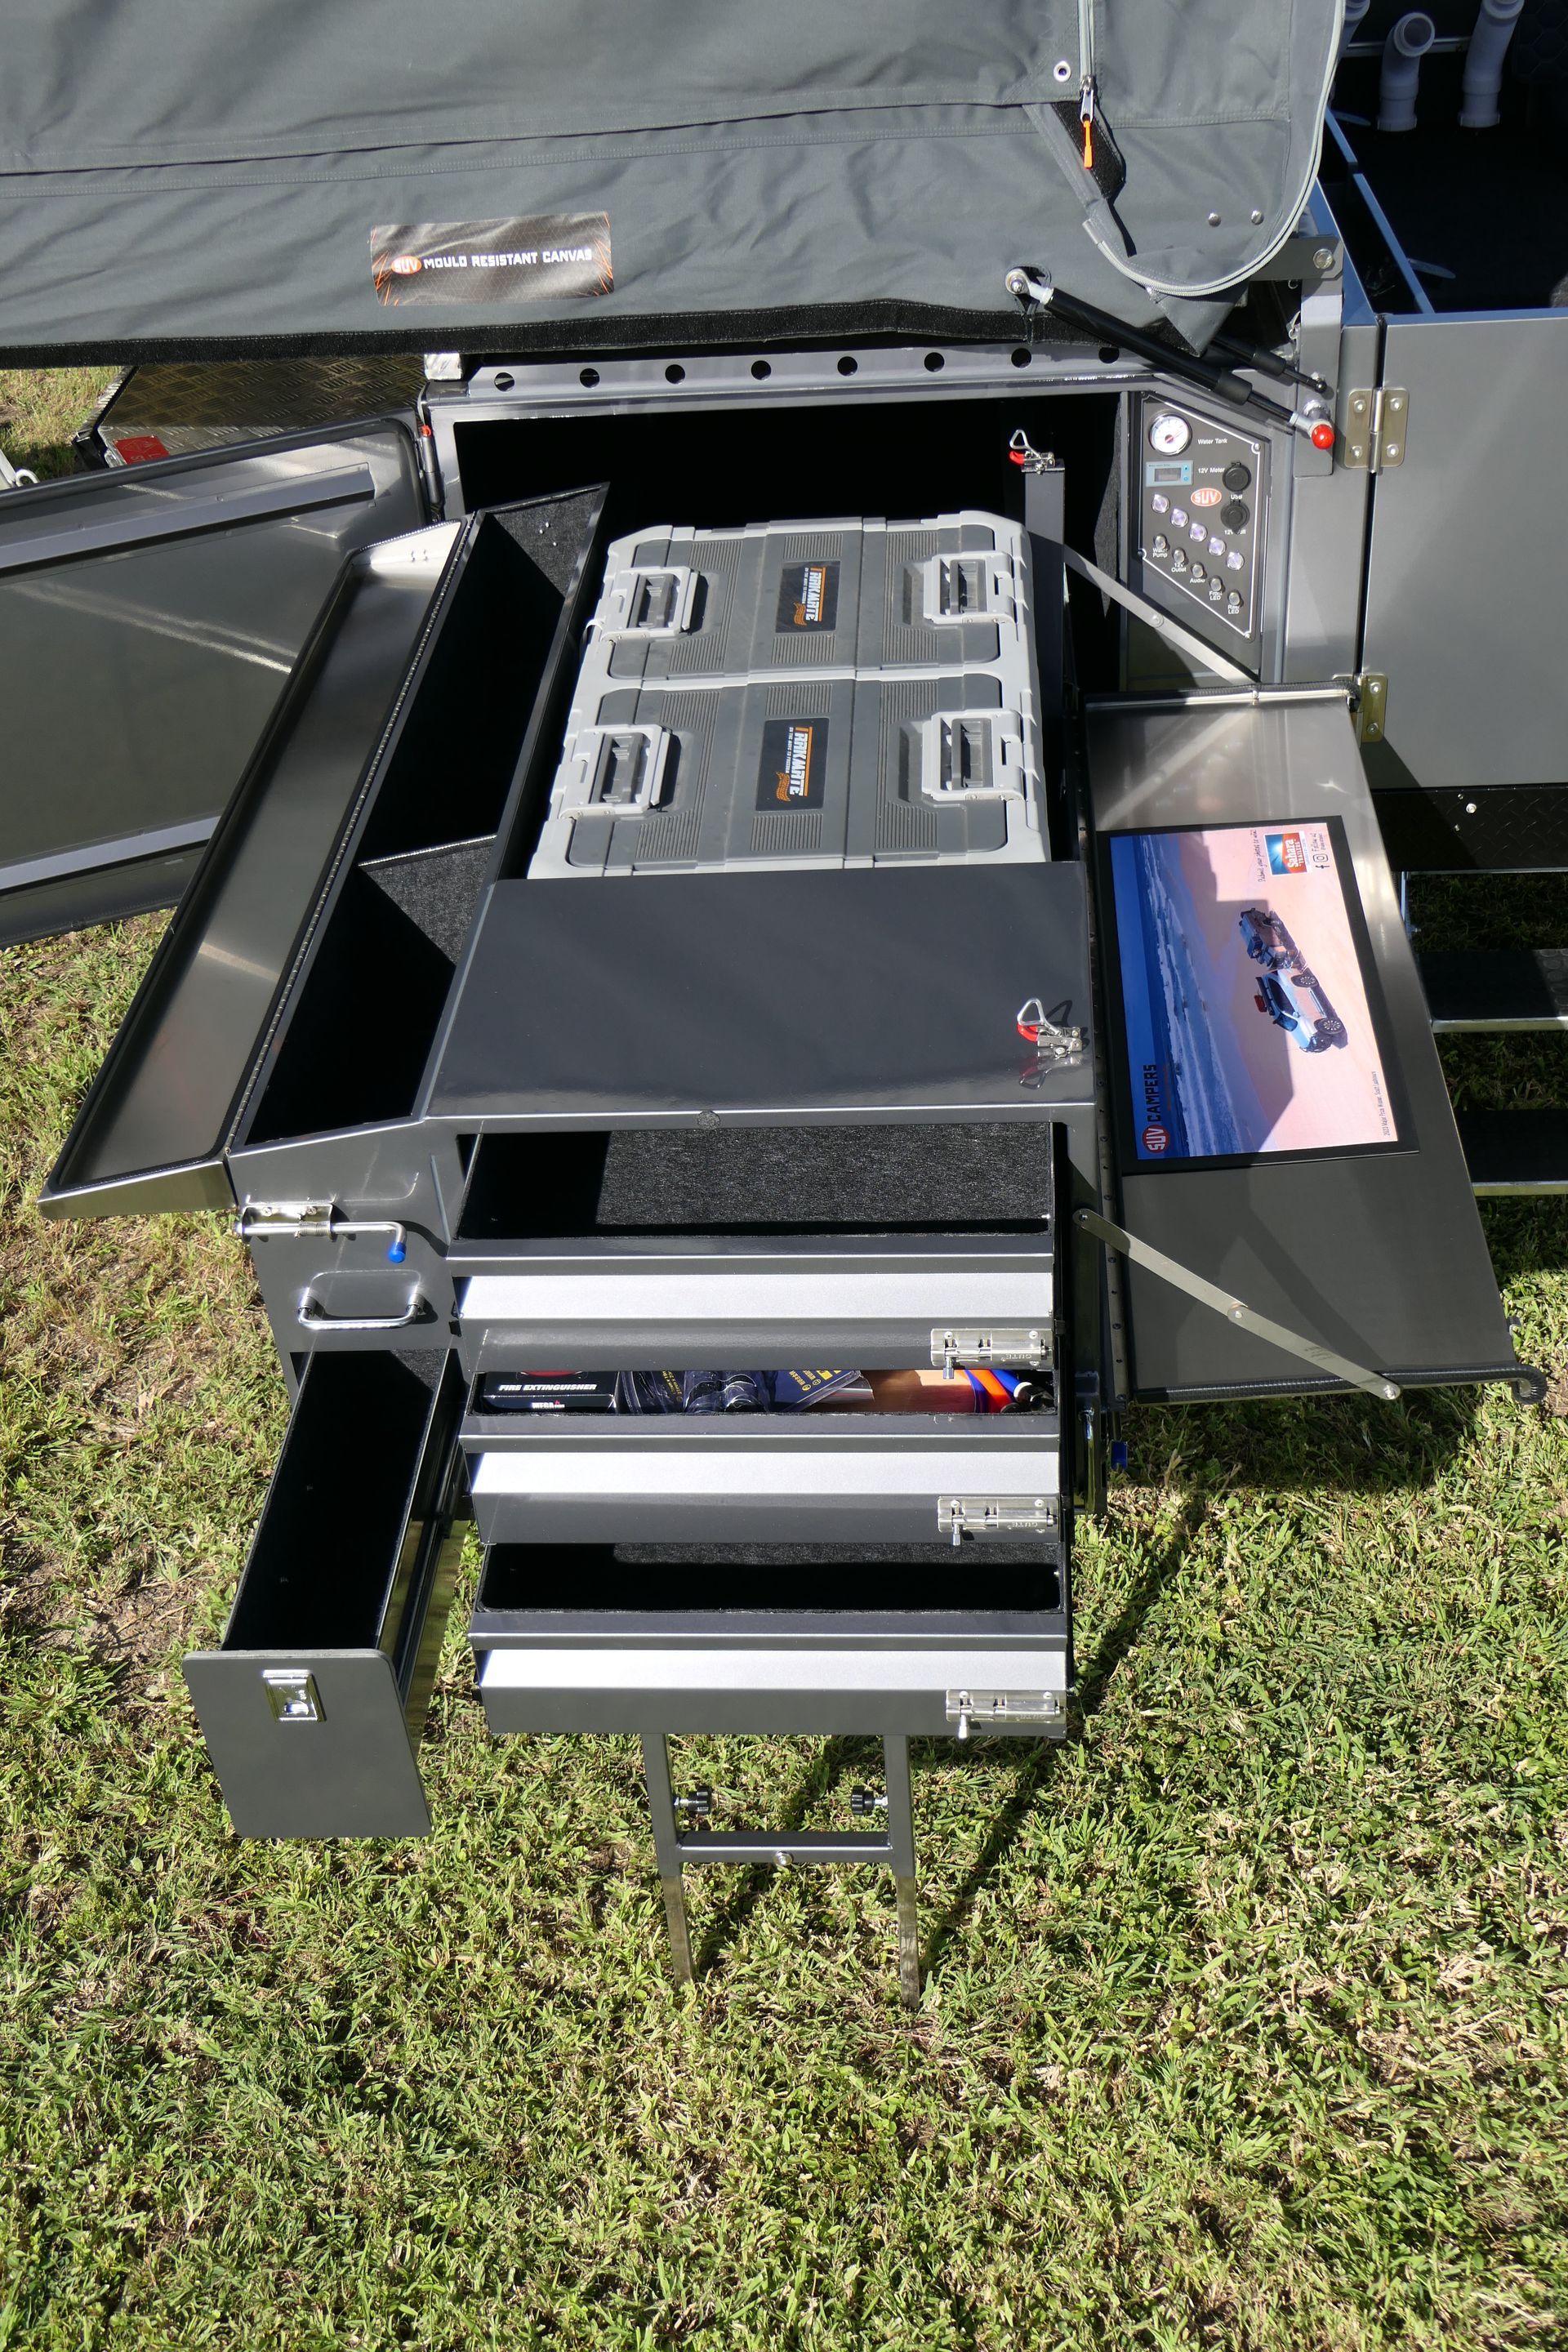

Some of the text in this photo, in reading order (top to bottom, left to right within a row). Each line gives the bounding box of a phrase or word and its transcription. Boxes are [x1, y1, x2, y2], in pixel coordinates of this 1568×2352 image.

[394, 247, 592, 272] SUV MOULD RESISTANT CANVAS
[1193, 490, 1218, 505] SUV
[1284, 839, 1299, 868] Sahara
[1143, 1064, 1166, 1151] SUV CAMPERS
[523, 1383, 598, 1391] EXTINGUISHER
